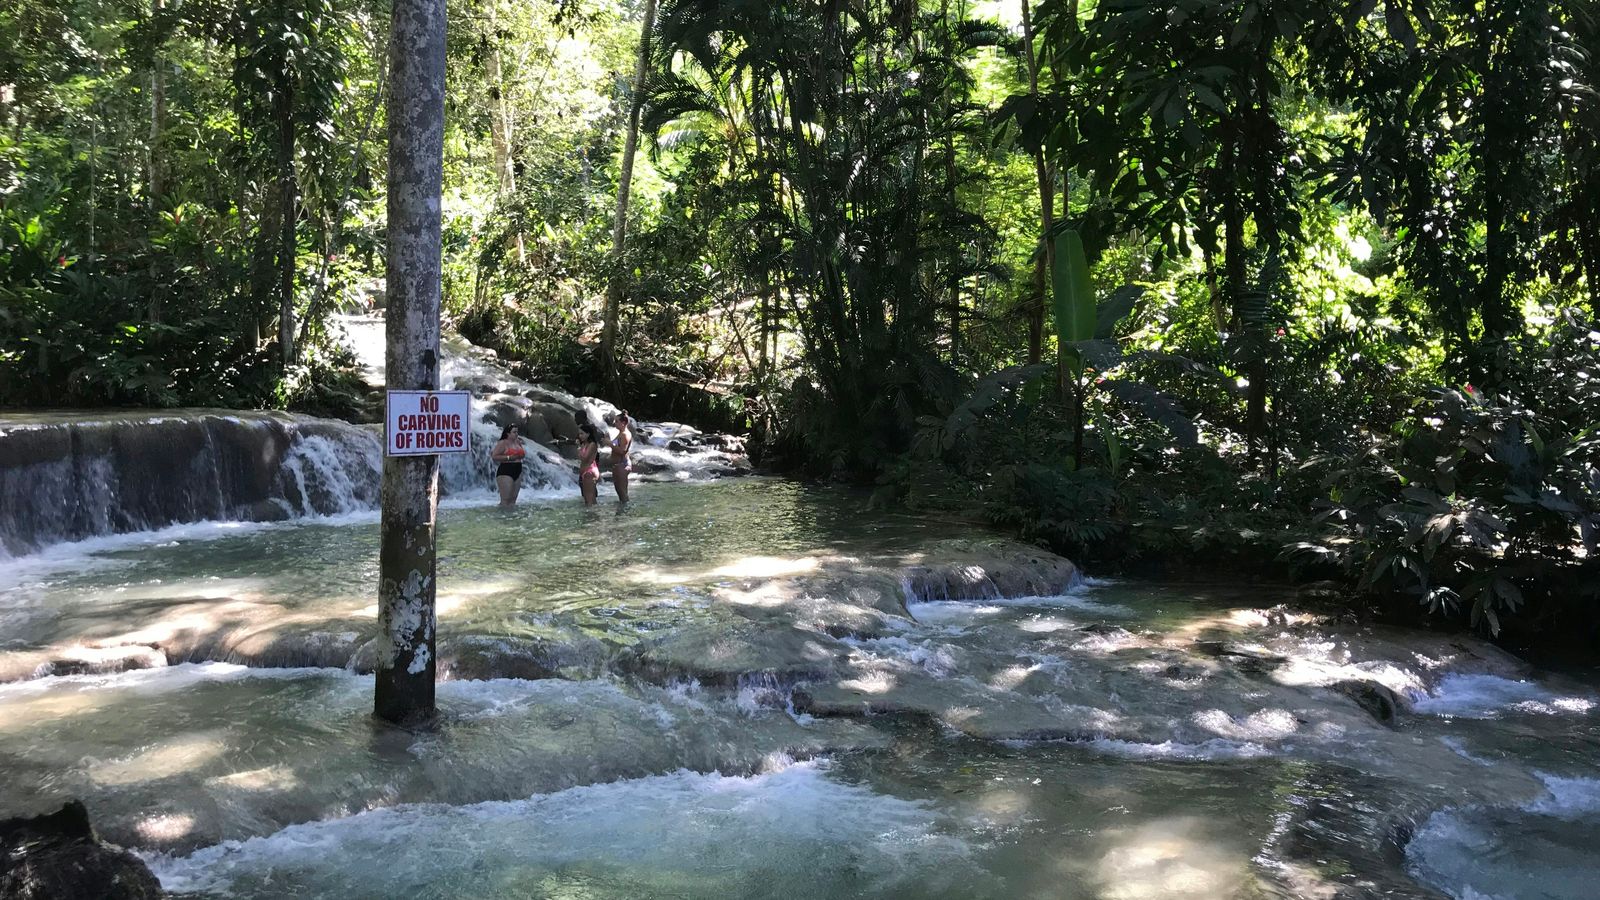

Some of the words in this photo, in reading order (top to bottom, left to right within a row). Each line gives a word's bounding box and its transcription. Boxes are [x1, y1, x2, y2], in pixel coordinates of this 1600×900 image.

[420, 396, 439, 413] NO
[398, 414, 461, 431] CARVING
[395, 432, 413, 449] OF
[416, 431, 463, 448] ROCKS
